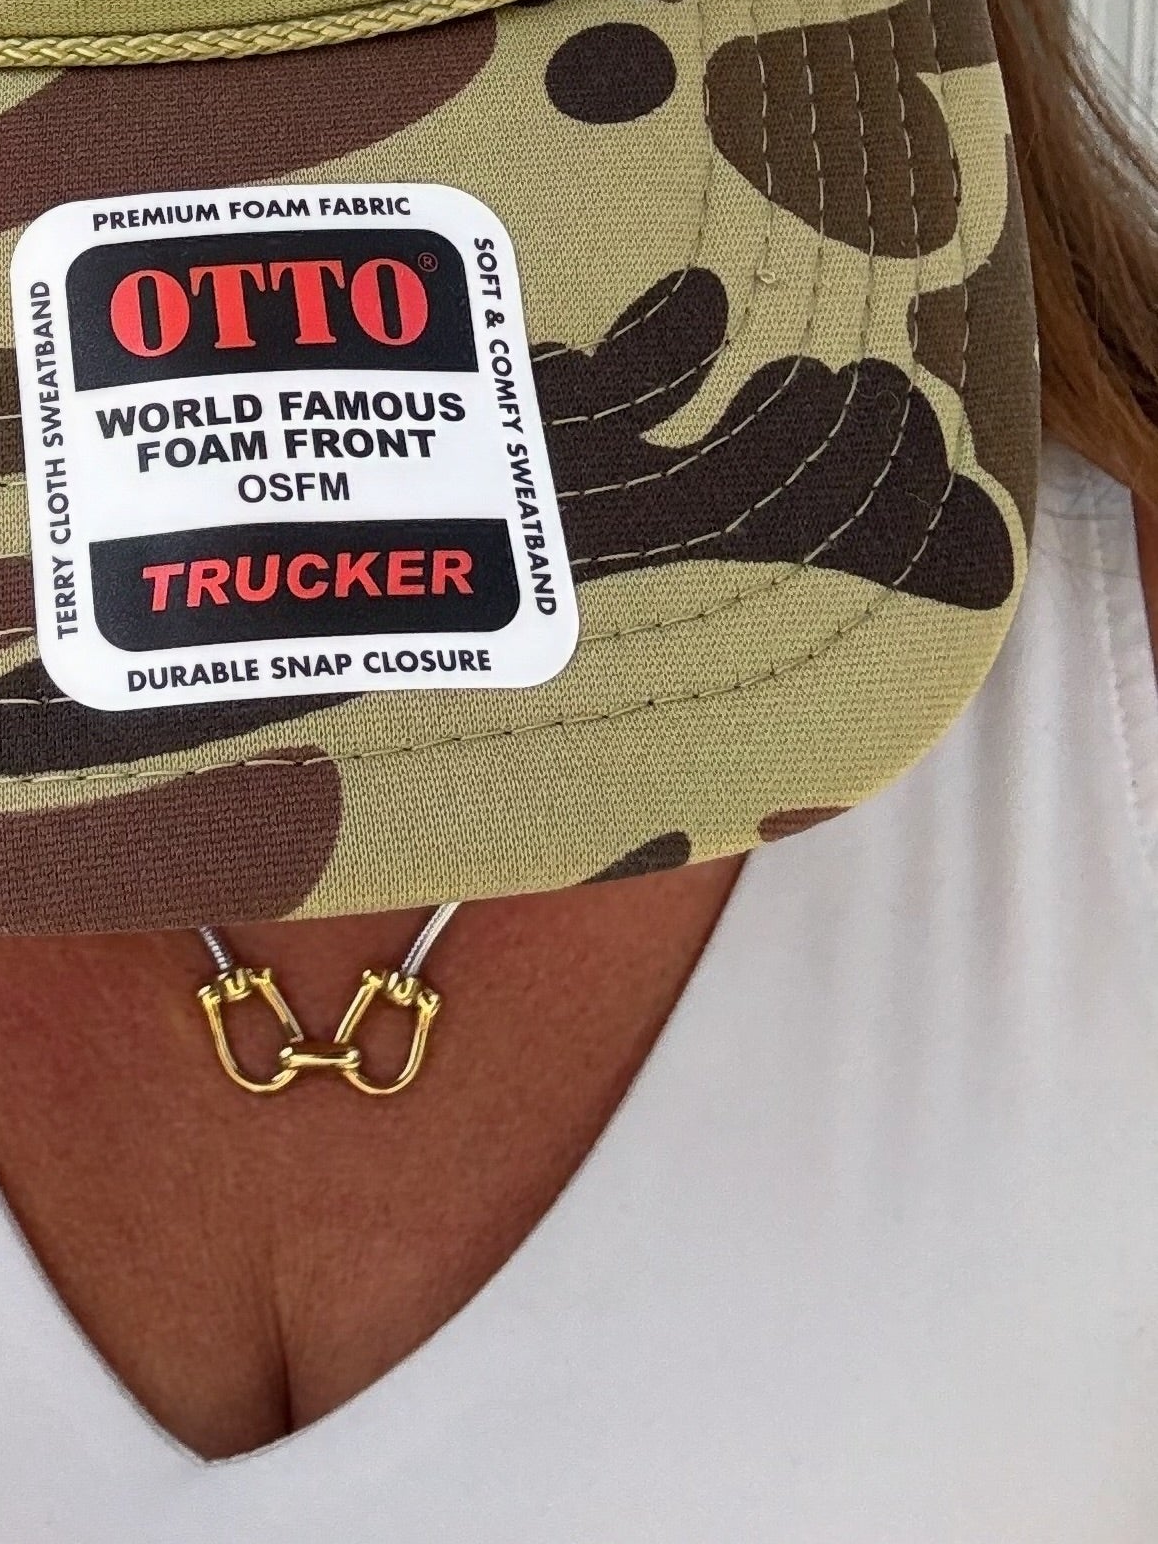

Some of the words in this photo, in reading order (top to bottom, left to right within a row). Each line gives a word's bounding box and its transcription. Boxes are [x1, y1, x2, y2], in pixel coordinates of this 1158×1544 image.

[93, 204, 219, 231] PREMIUM
[229, 199, 310, 219] FOAM
[319, 198, 410, 215] FABRIC
[474, 238, 501, 299] SOFT
[485, 309, 504, 328] &
[30, 280, 64, 448] SWEATBAND
[489, 339, 523, 433] COMFY
[95, 394, 263, 440] WORLD
[279, 391, 465, 421] FAMOUS
[137, 431, 268, 472] FOAM
[284, 429, 436, 458] FRONT
[45, 459, 71, 544] CLOTH
[238, 472, 349, 503] OSFM
[506, 442, 558, 617] SWEATBAND
[53, 557, 77, 639] TERRY
[141, 549, 474, 612] TRUCKER
[128, 659, 259, 691] DURABLE
[271, 654, 351, 679] SNAP
[363, 650, 491, 673] CLOSURE
